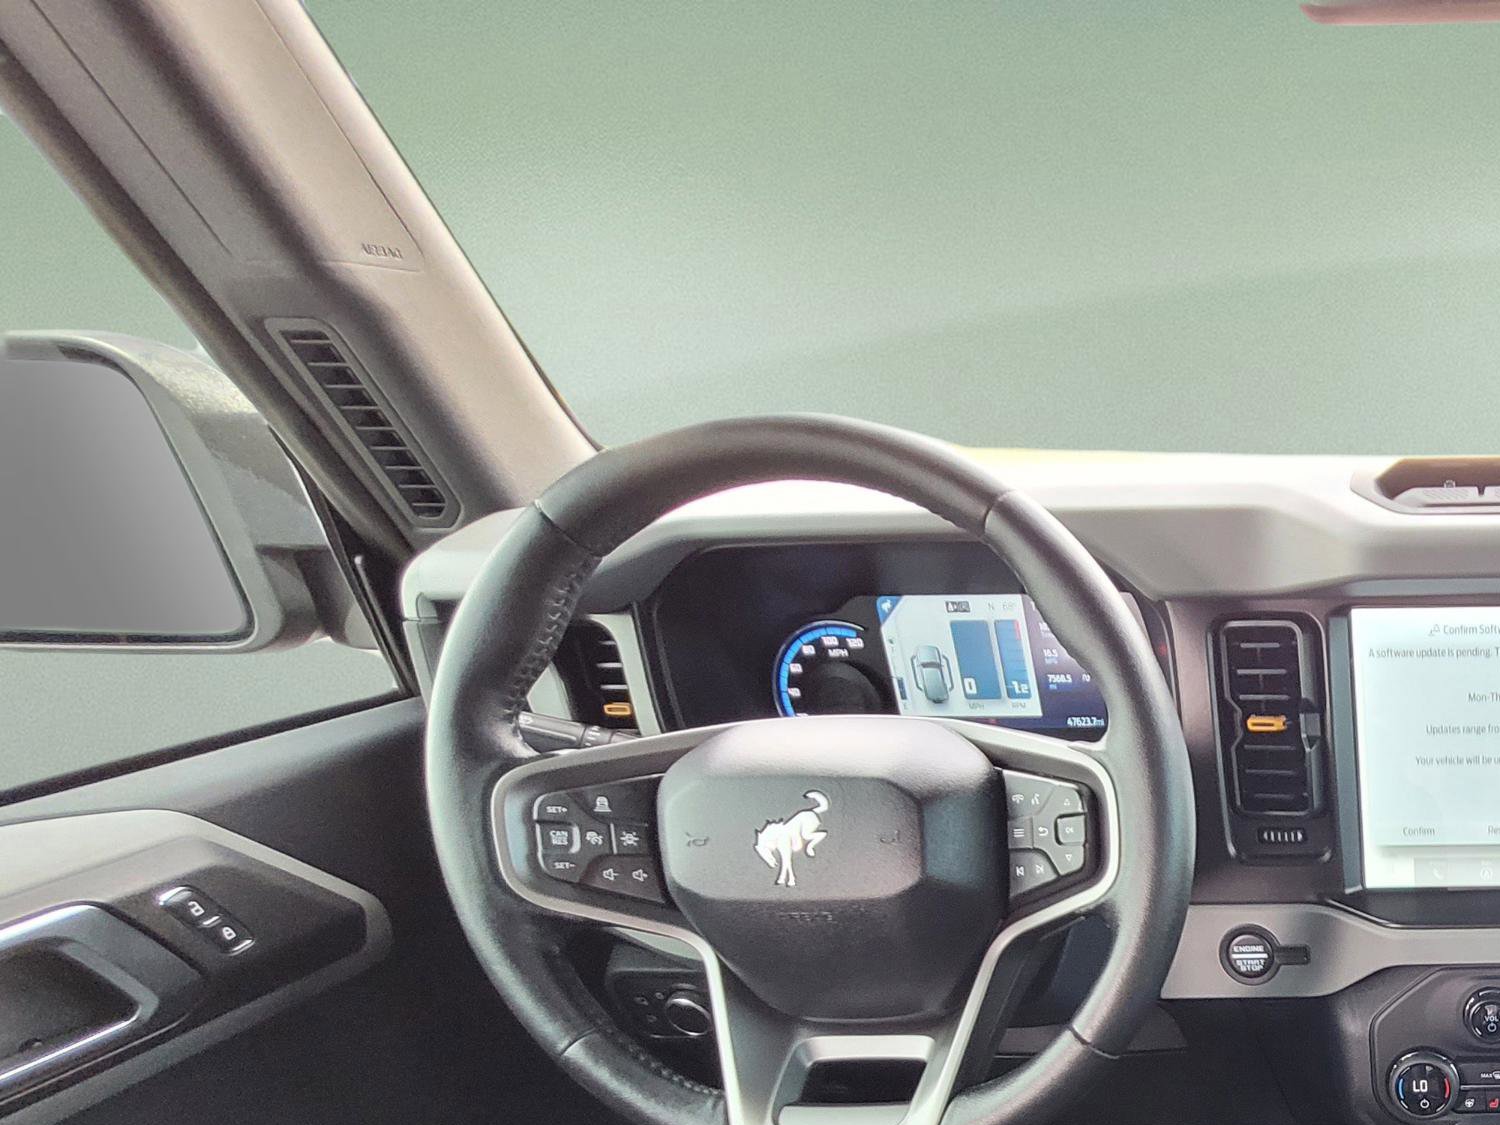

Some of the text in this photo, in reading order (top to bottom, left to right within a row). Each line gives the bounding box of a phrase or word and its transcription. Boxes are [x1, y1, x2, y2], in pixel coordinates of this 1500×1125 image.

[1443, 625, 1478, 635] Confirm
[828, 649, 849, 657] MPH
[1368, 648, 1375, 657] A
[1376, 648, 1415, 658] software
[1416, 647, 1447, 659] update
[963, 677, 978, 695] 0
[1426, 724, 1461, 735] Updates
[1462, 725, 1486, 735] range
[1416, 755, 1434, 766] Your
[1435, 755, 1464, 765] vehicle
[1466, 755, 1480, 765] will
[1481, 755, 1493, 765] be
[549, 830, 569, 838] CAN
[1402, 826, 1436, 836] Confirm
[1412, 1079, 1428, 1093] LO
